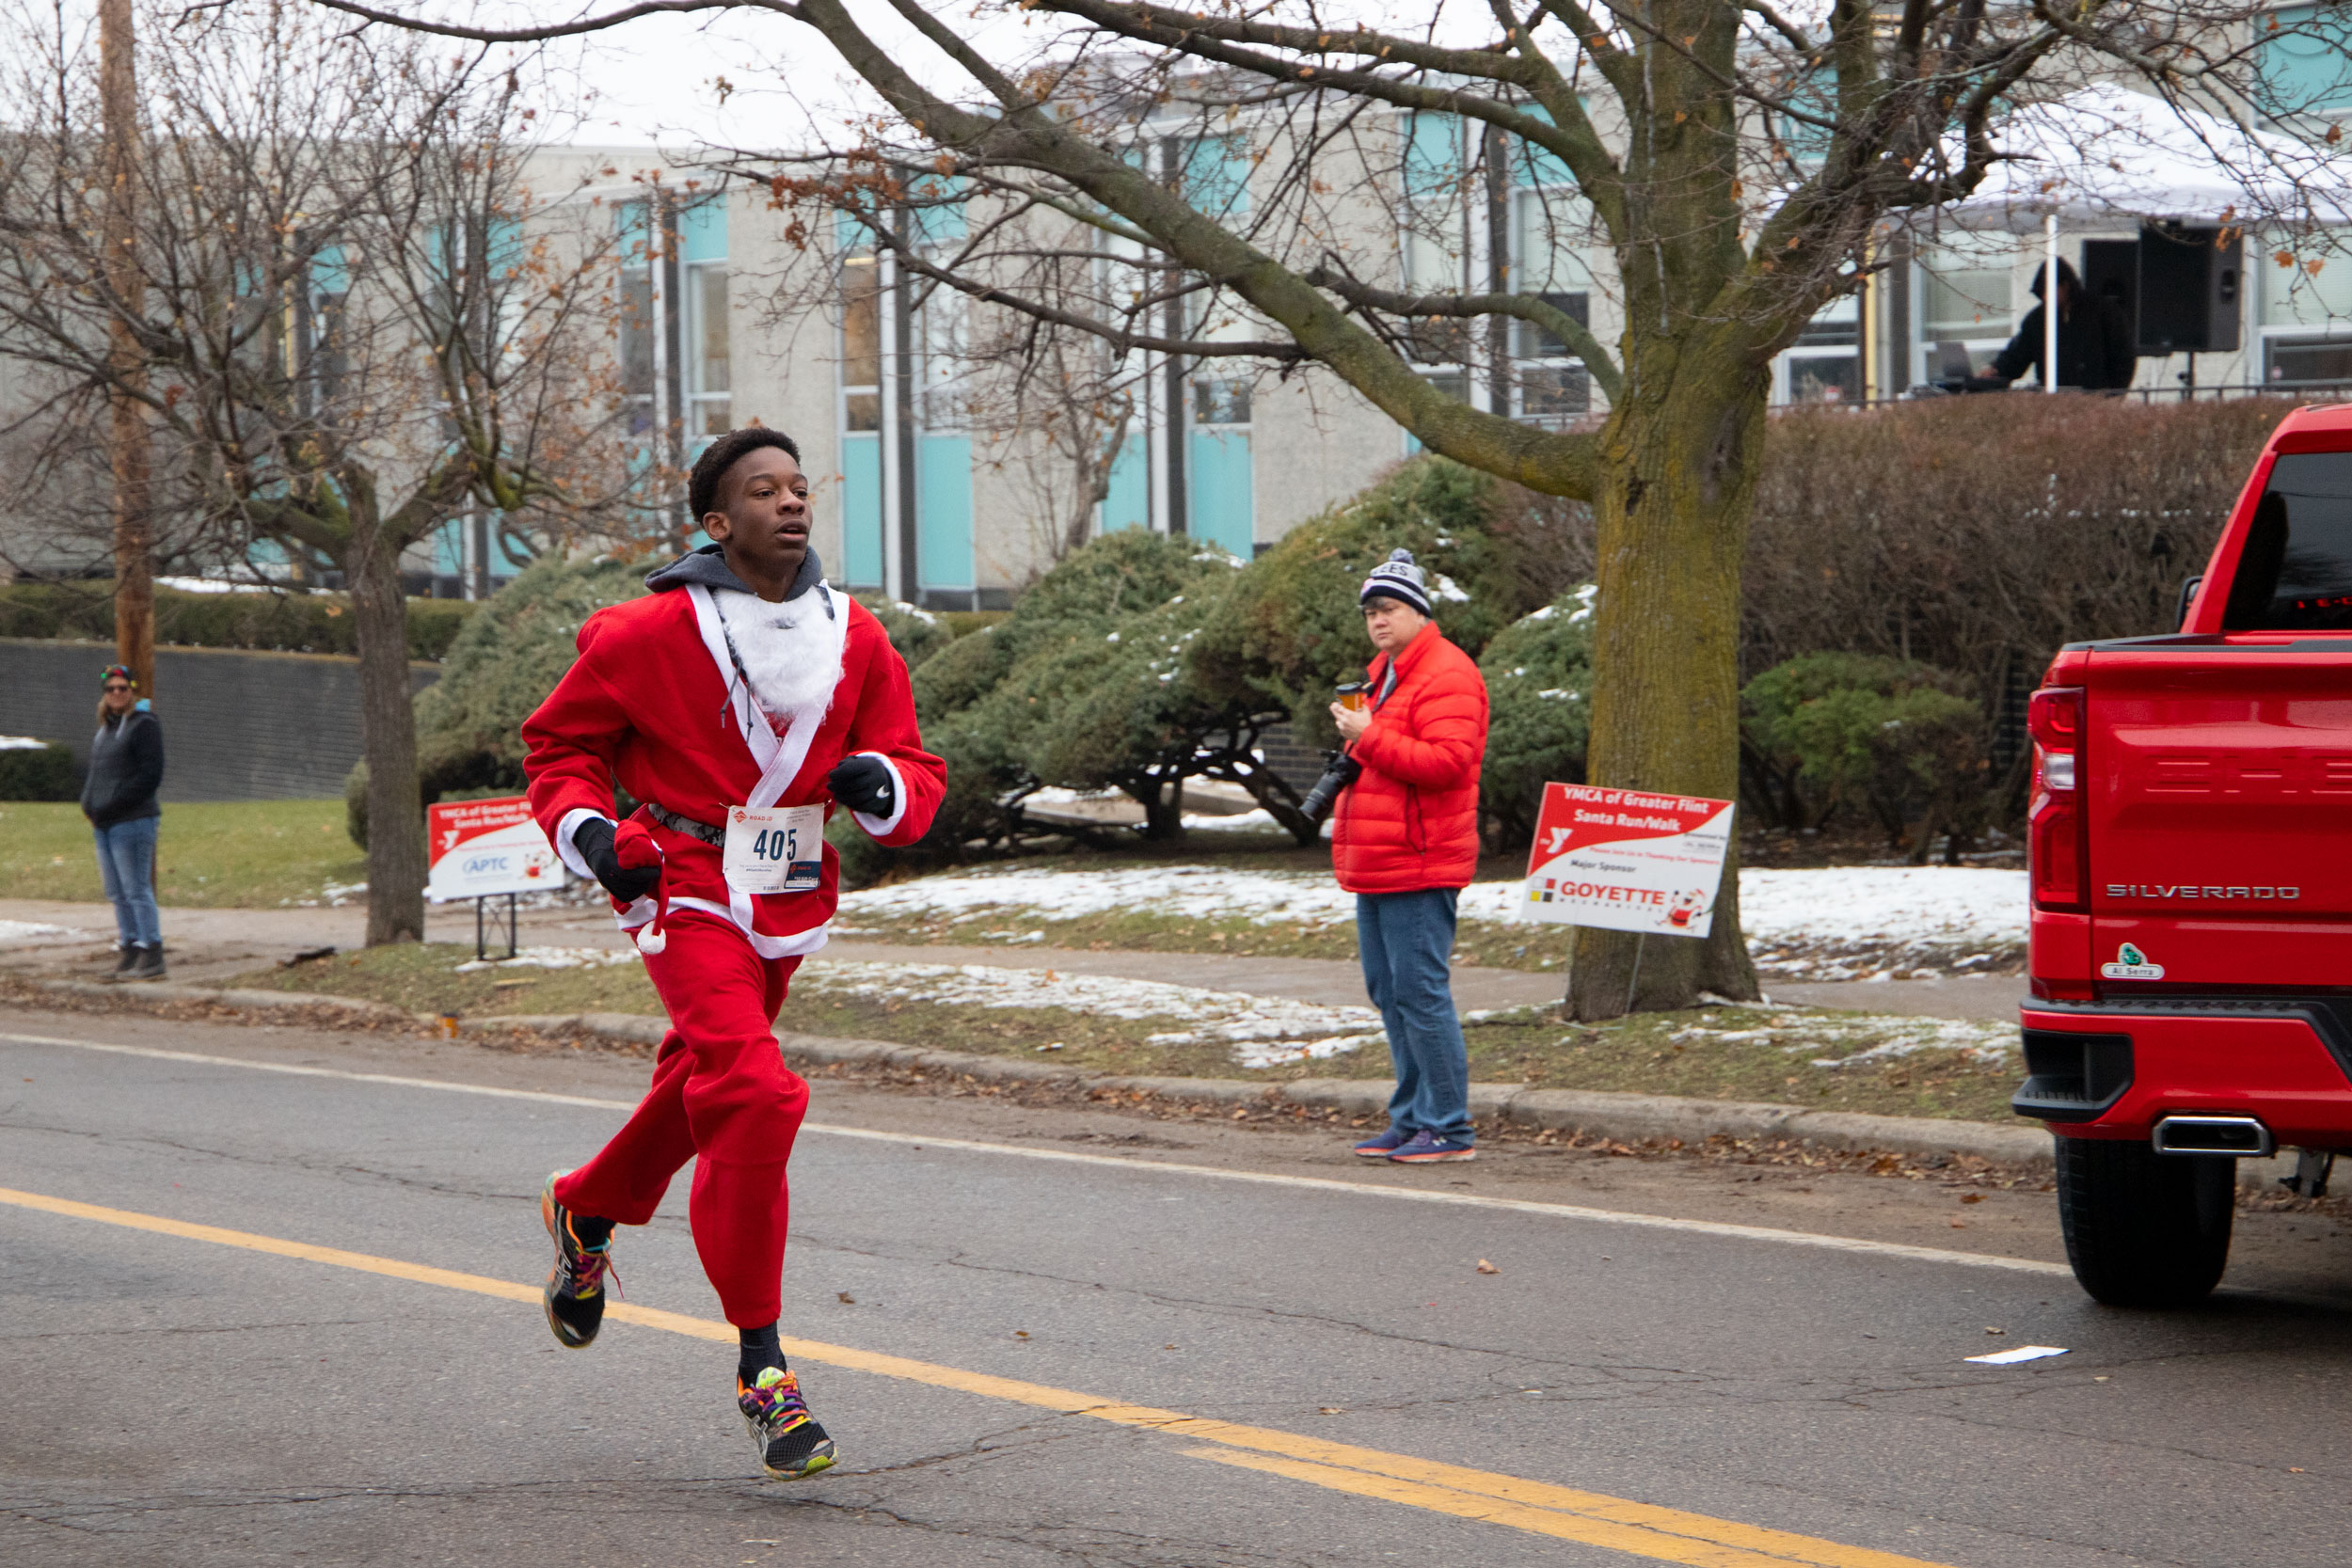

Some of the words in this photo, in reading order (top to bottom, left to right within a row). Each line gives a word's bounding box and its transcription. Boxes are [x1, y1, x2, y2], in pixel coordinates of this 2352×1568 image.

[1564, 787, 1601, 802] YMCA
[1605, 793, 1622, 804] of
[1624, 794, 1675, 810] Greater
[1677, 798, 1709, 814] Flint
[438, 809, 467, 819] YMCA
[469, 807, 480, 816] of
[482, 803, 517, 816] Greater
[453, 818, 482, 830] Santa
[483, 814, 529, 826] Run/Walk
[1574, 809, 1613, 825] Santa
[1615, 813, 1681, 832] Run/Walk
[753, 828, 797, 861] 405
[469, 857, 509, 873] APTC
[1570, 860, 1597, 872] Major
[1599, 862, 1637, 874] Sponsor
[1561, 881, 1666, 905] GOYETTE
[2106, 884, 2300, 899] SILVERADO
[2126, 967, 2153, 975] Serra
